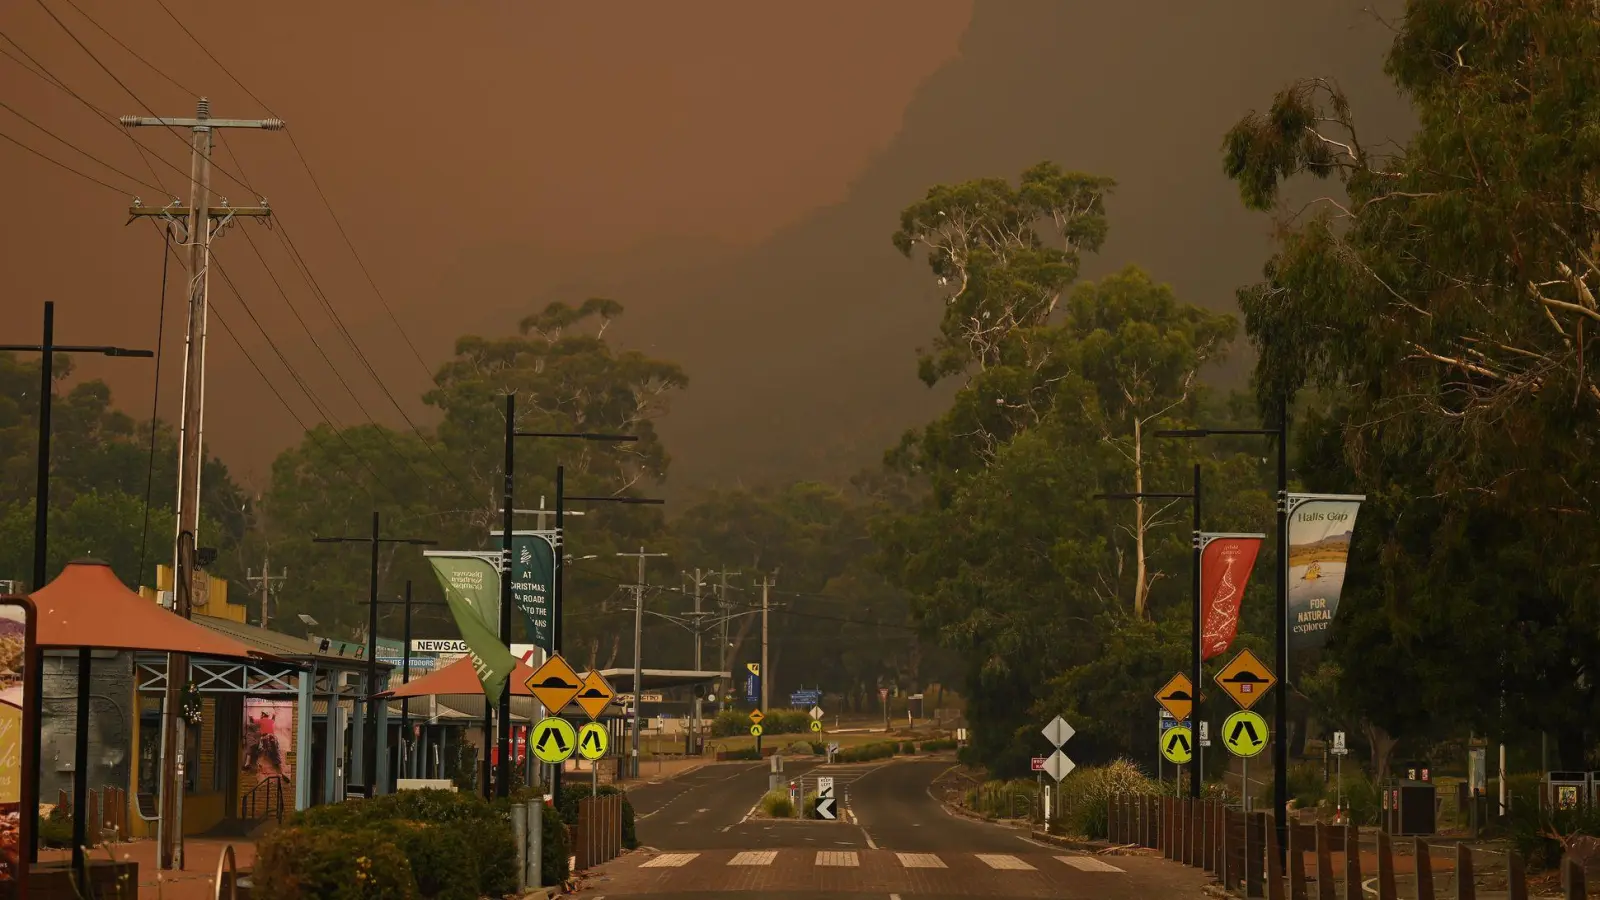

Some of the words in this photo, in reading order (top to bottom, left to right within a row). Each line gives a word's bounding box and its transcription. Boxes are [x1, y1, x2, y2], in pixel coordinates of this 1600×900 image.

[1298, 512, 1325, 522] Halls
[1327, 512, 1348, 522] Gap
[523, 571, 532, 579] AT
[523, 594, 545, 603] ROADS
[1310, 598, 1326, 609] FOR
[535, 607, 547, 616] THE
[1297, 610, 1332, 623] NATURAL
